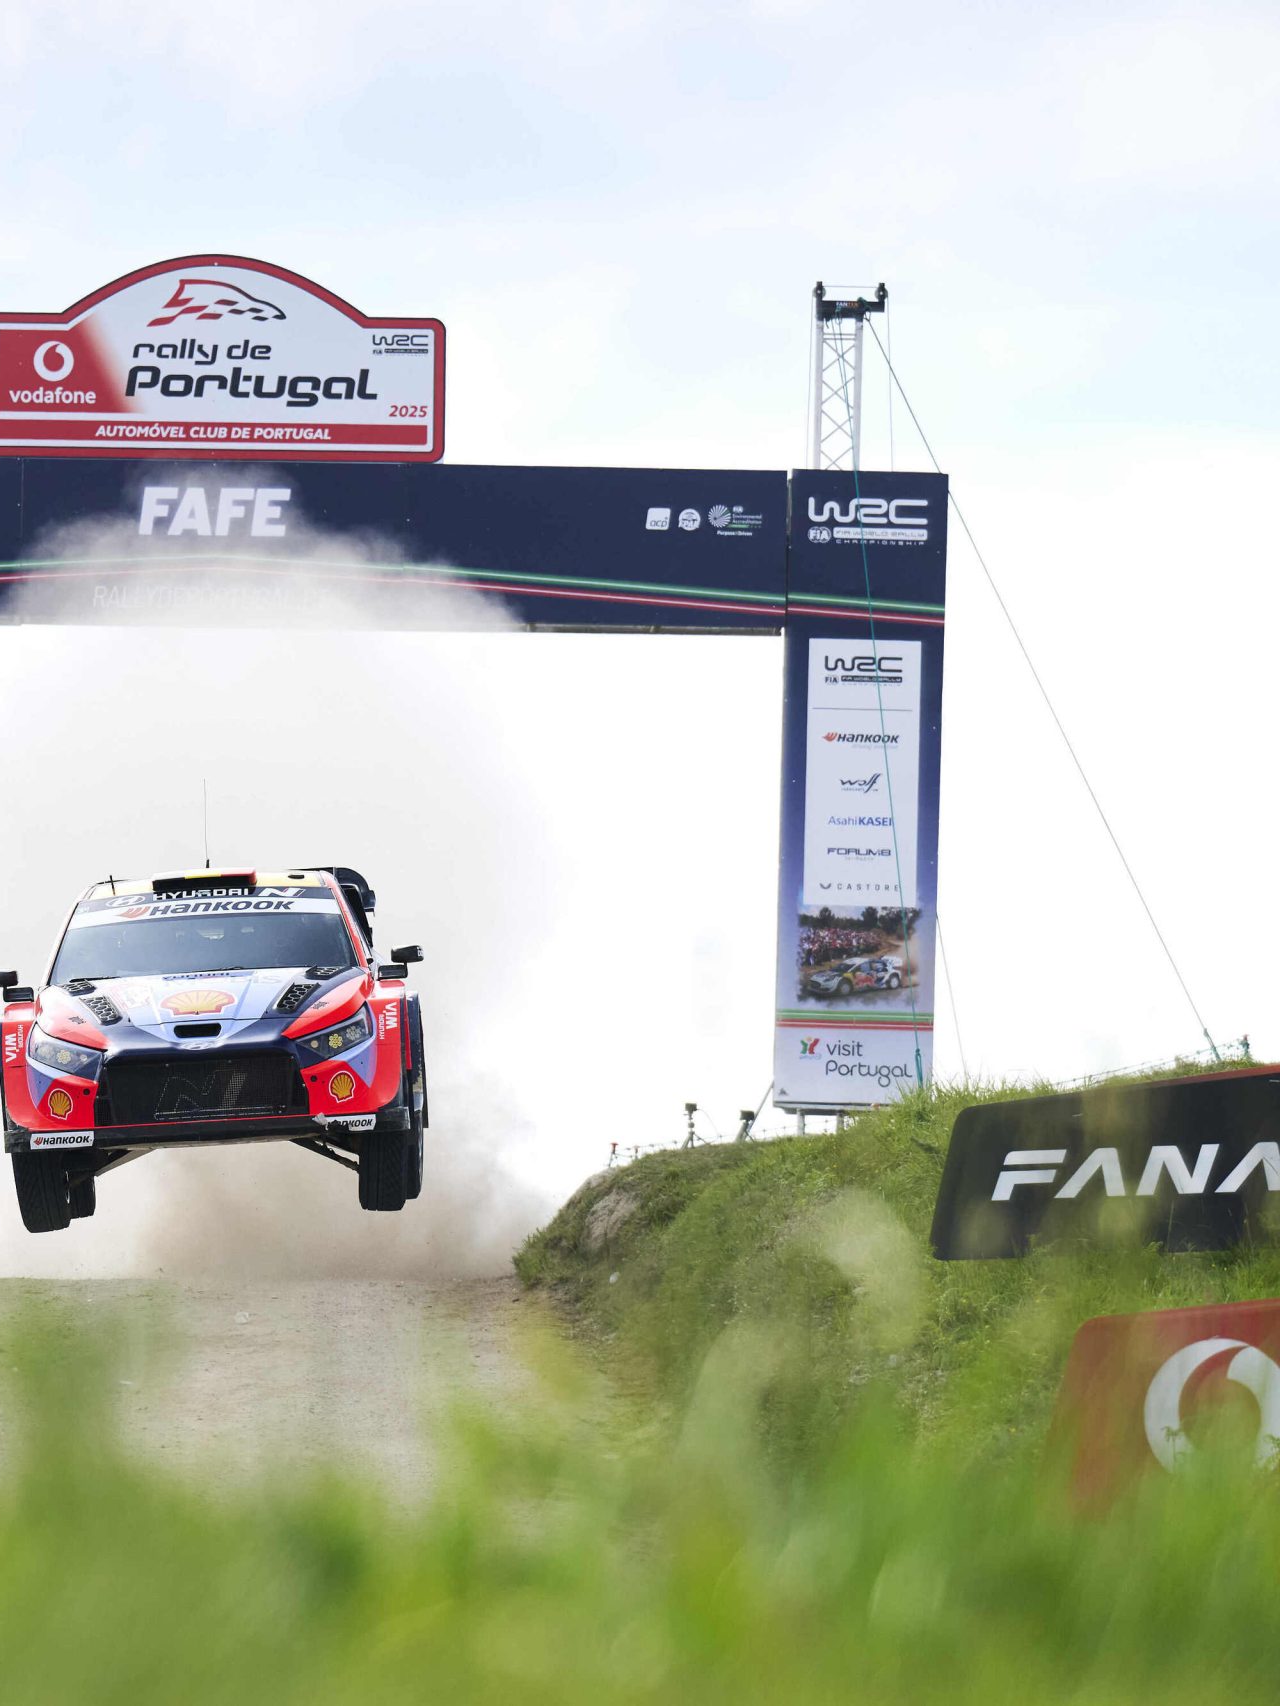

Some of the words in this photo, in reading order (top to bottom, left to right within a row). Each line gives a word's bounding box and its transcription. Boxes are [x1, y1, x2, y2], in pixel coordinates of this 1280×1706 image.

[372, 334, 429, 346] WRC
[133, 338, 218, 365] rally
[227, 339, 272, 360] de
[9, 387, 96, 404] vodafone
[125, 365, 378, 408] Portugal
[388, 405, 429, 418] 2025
[95, 424, 186, 438] AUTOMÓVEL
[189, 427, 227, 439] CLUB
[230, 428, 251, 439] DE
[253, 429, 332, 441] PORTUGAL
[138, 486, 292, 537] FAFE
[808, 496, 929, 525] WRC
[824, 655, 903, 673] WRC
[827, 815, 892, 827] AsahiKASEI
[152, 887, 249, 902] HYUNDAI
[836, 882, 899, 892] CASTORE
[826, 1039, 864, 1057] visit
[824, 1059, 913, 1088] Portugal
[991, 1141, 1280, 1201] FANA
